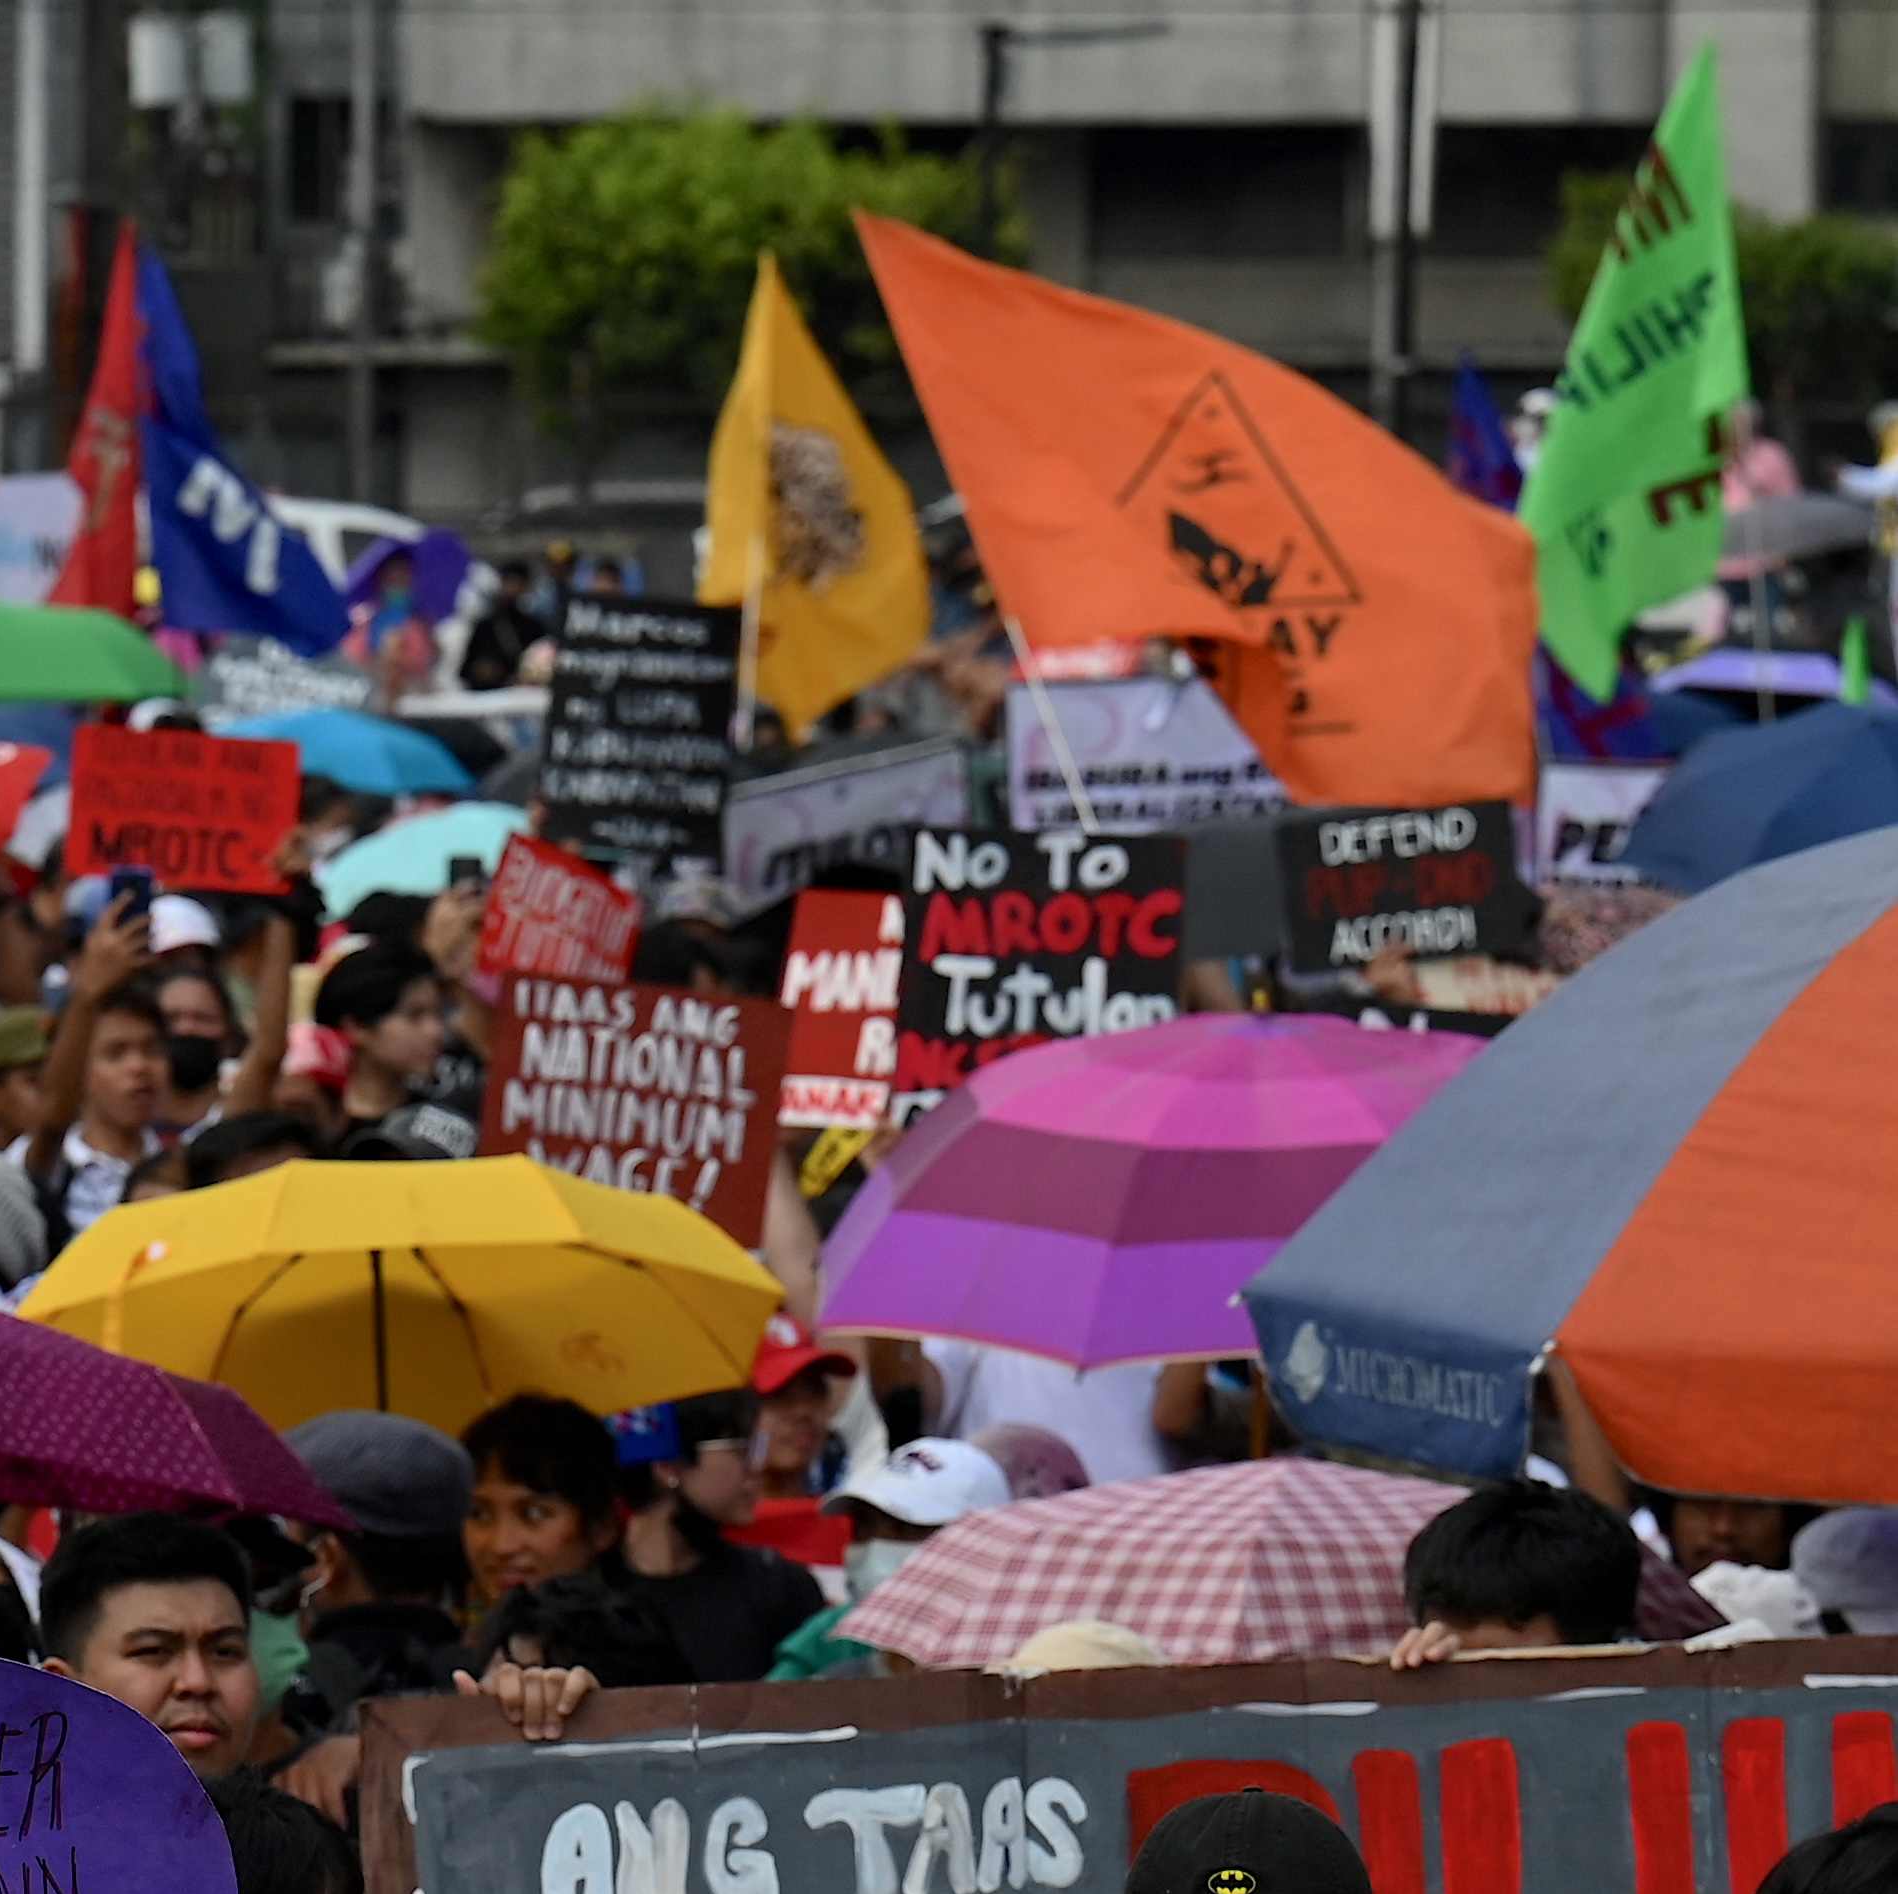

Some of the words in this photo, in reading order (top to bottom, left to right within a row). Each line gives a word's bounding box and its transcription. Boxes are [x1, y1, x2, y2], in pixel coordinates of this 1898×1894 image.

[912, 831, 1011, 893] No
[1036, 832, 1131, 891] To
[1317, 805, 1479, 867] DEFEND
[916, 887, 1183, 962] MROTC
[513, 976, 637, 1031] ITAAS
[652, 994, 742, 1049] ANG
[519, 1020, 759, 1107] NATIONAL
[501, 1078, 748, 1163] MINIMUM
[1334, 1345, 1504, 1430] MICROMATIC
